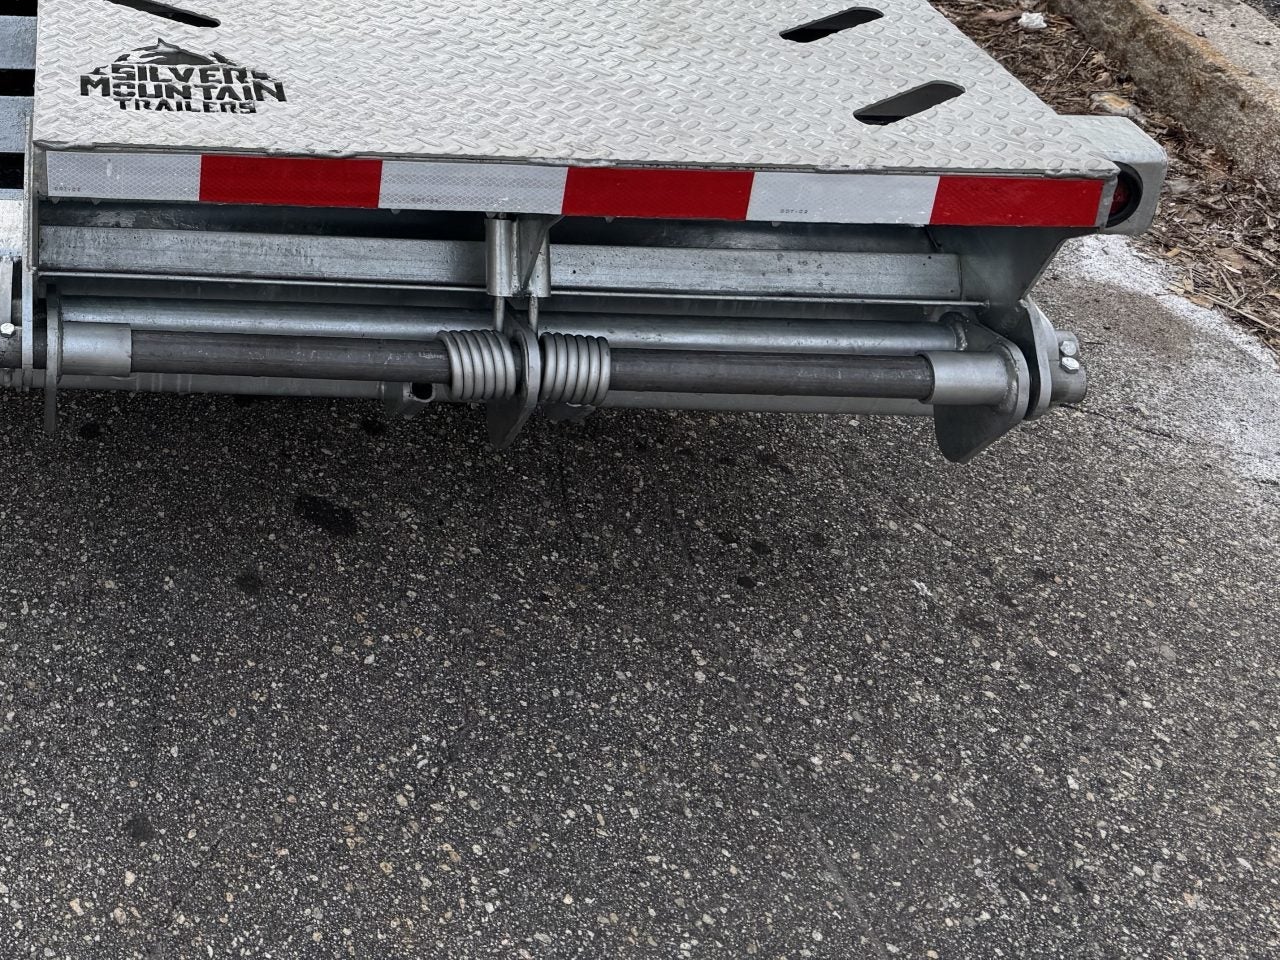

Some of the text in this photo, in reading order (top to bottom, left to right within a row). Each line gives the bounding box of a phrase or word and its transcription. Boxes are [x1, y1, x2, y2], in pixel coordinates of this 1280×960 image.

[111, 63, 249, 85] SILVER
[80, 75, 287, 102] MOUNTAIN
[113, 98, 257, 114] TRAILERS
